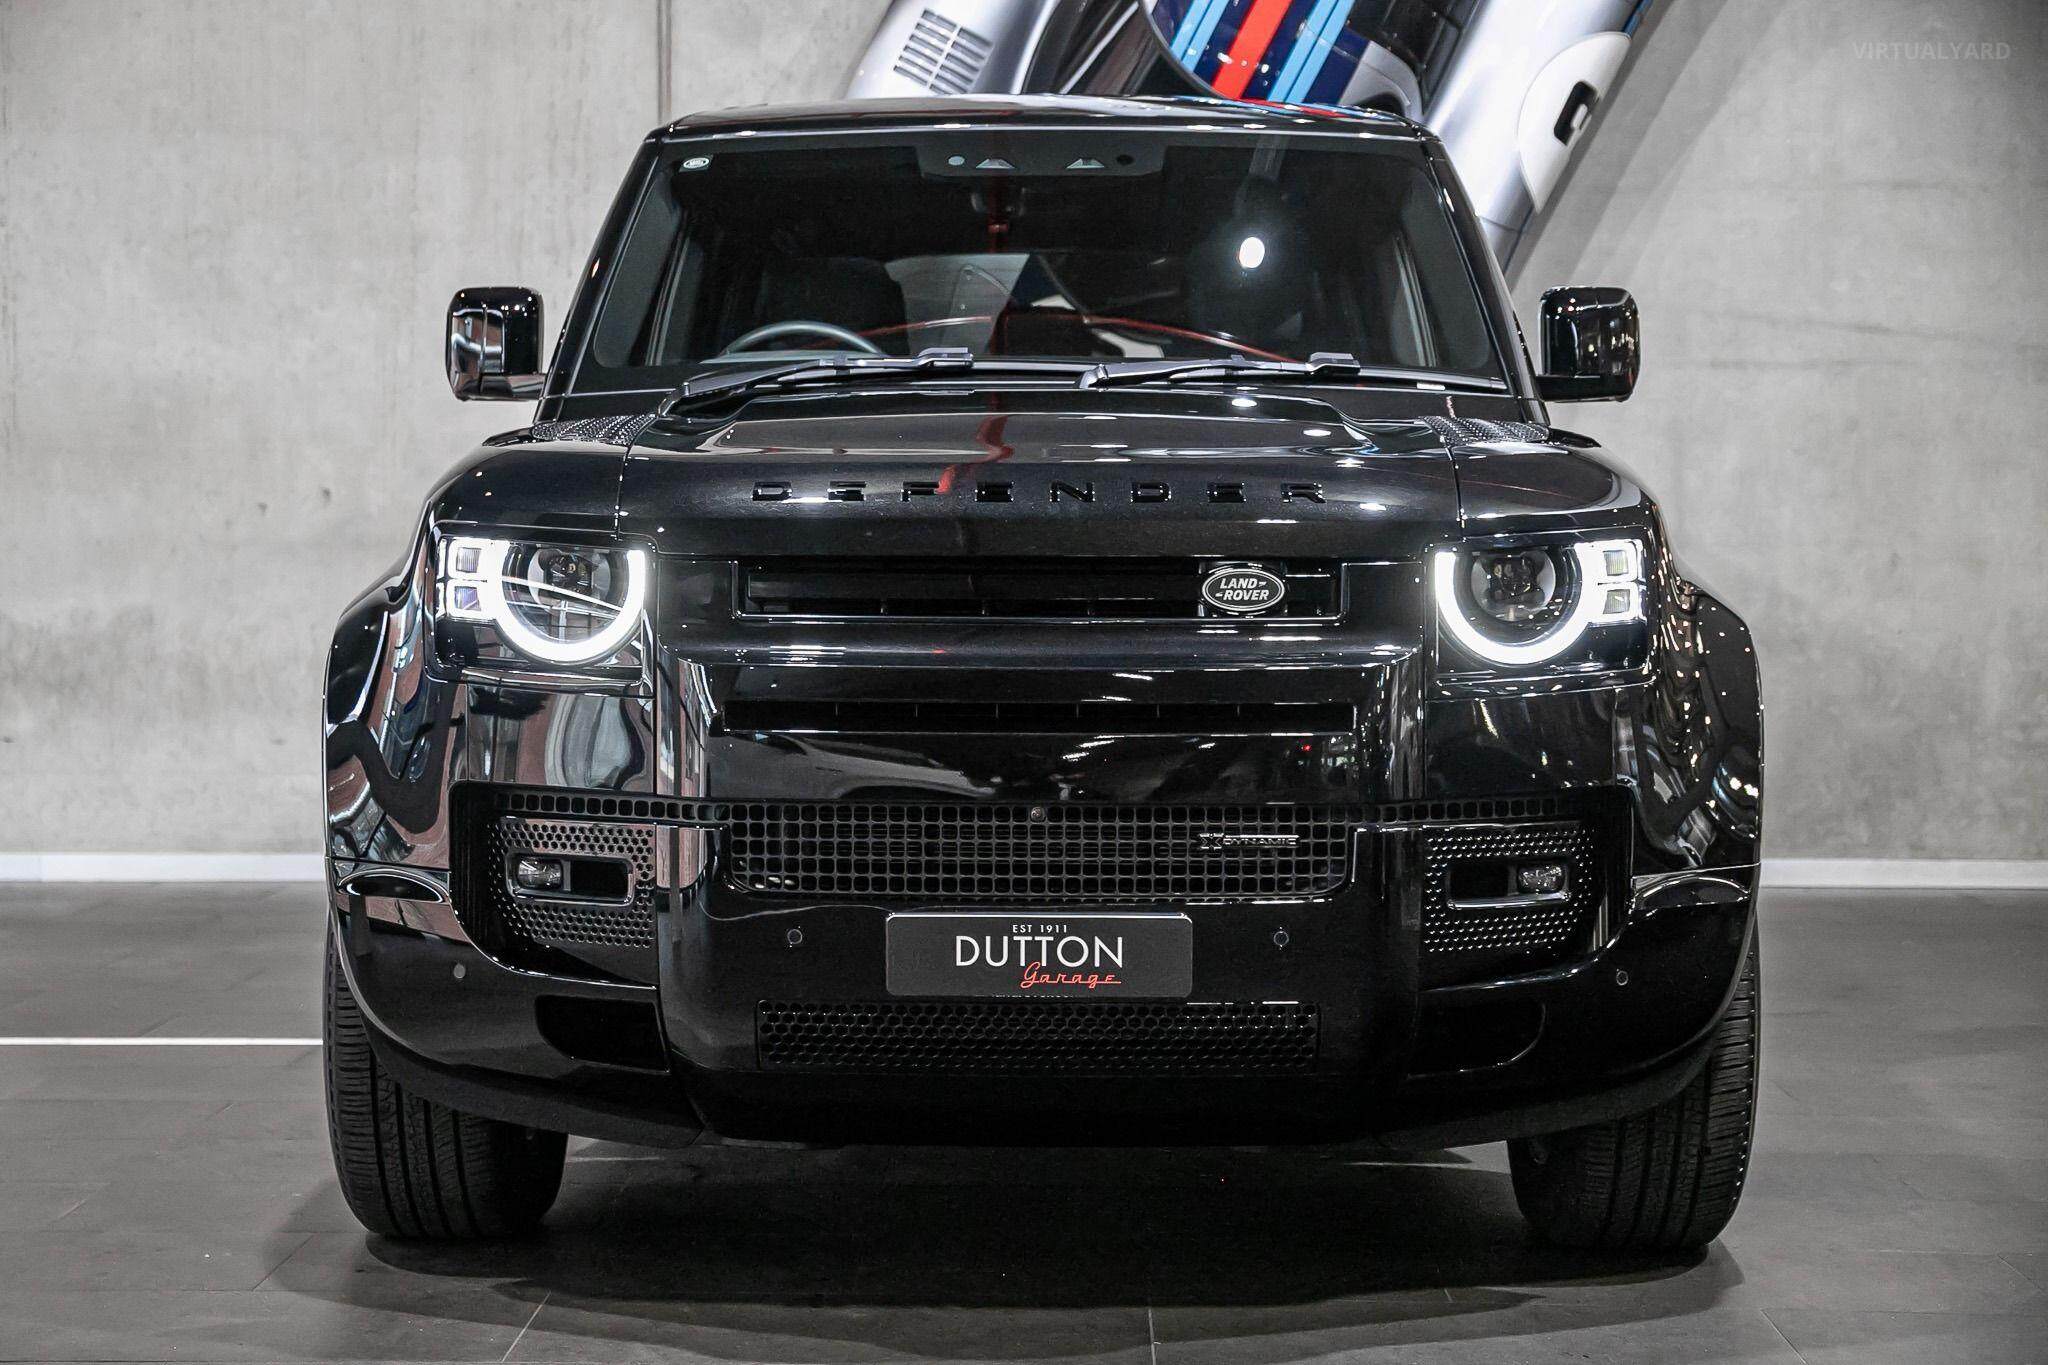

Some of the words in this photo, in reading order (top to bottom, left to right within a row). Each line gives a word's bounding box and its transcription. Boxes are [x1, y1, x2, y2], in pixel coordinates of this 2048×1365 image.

[751, 480, 1326, 503] DEFENDER
[1219, 577, 1258, 589] LAND
[1222, 589, 1270, 601] ROVER
[1012, 924, 1033, 934] EST
[1039, 924, 1068, 934] 1911
[955, 935, 1123, 968] DUTTON
[1020, 961, 1122, 989] Garage
